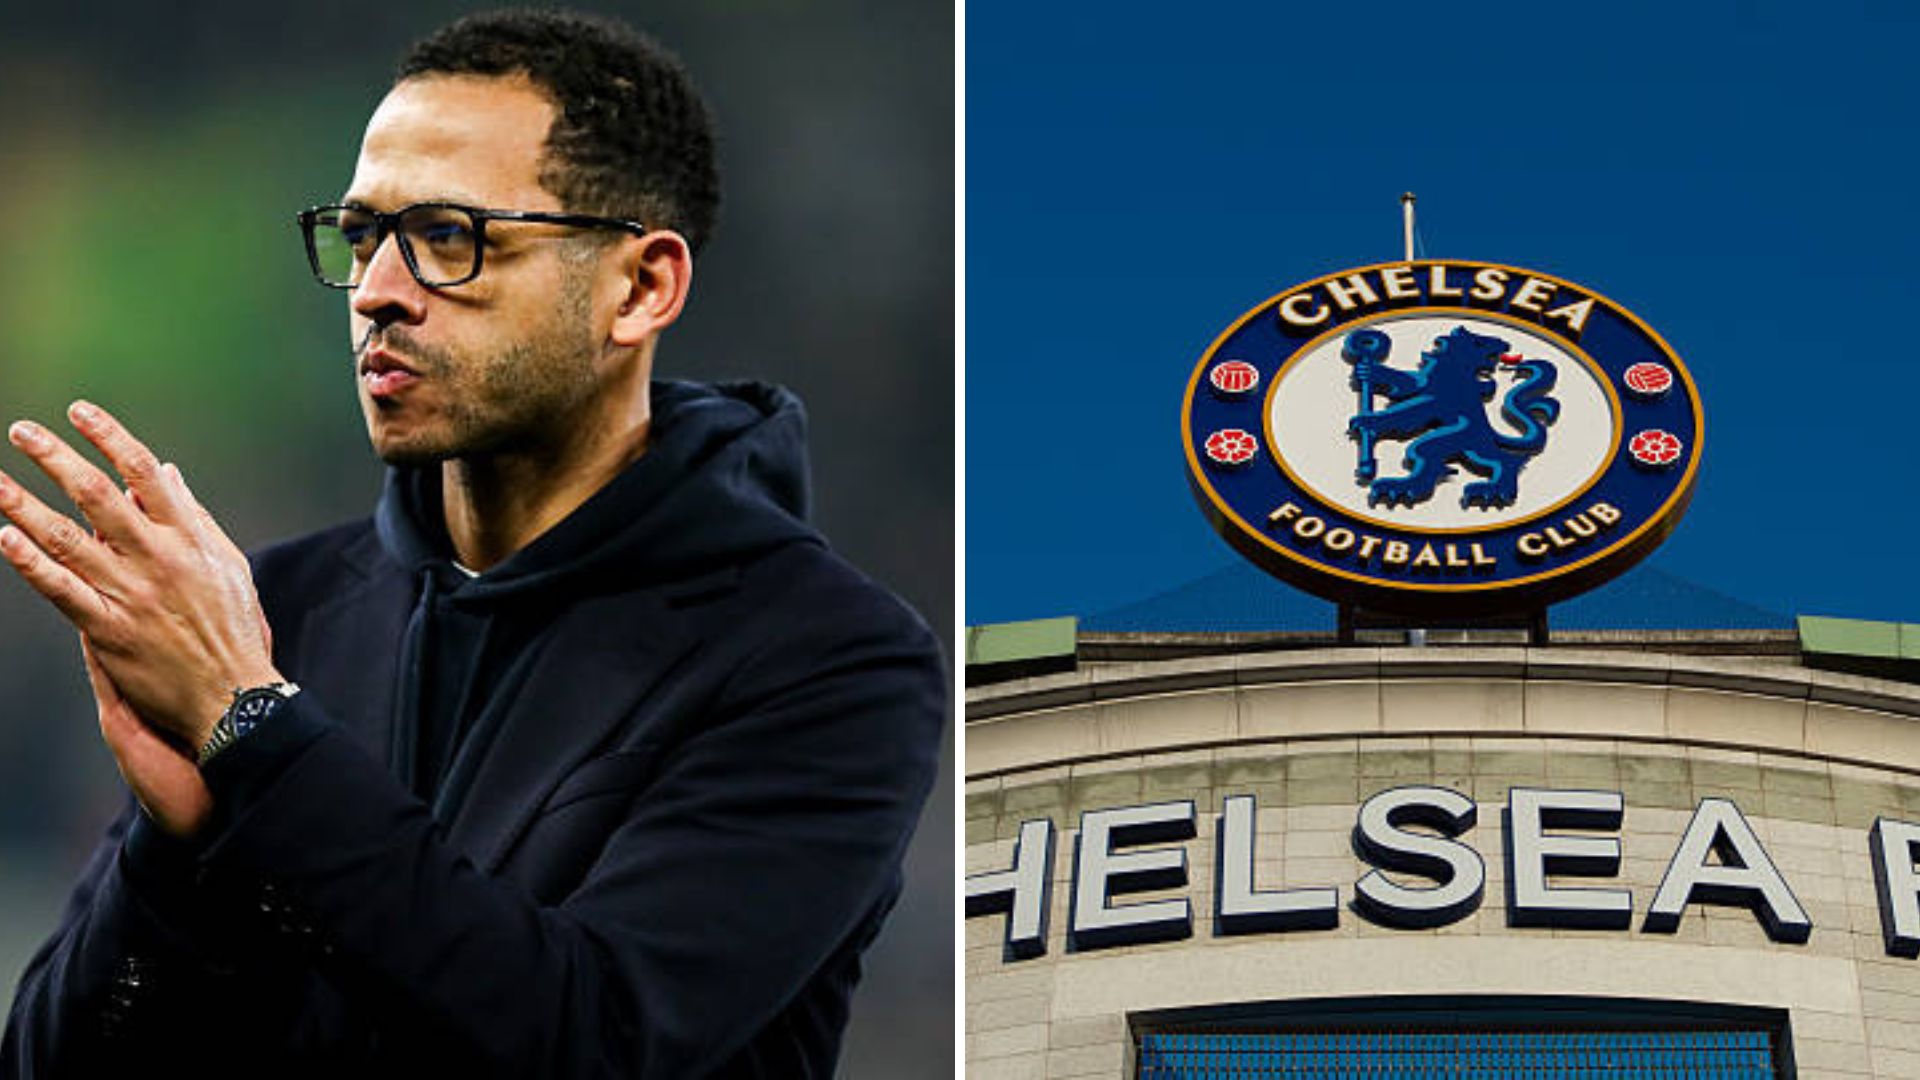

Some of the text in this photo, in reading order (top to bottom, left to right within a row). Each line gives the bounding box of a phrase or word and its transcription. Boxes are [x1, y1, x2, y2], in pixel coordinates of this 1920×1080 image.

[1279, 264, 1597, 332] CHELSEA
[1268, 502, 1623, 567] FOOTBALL CLUB
